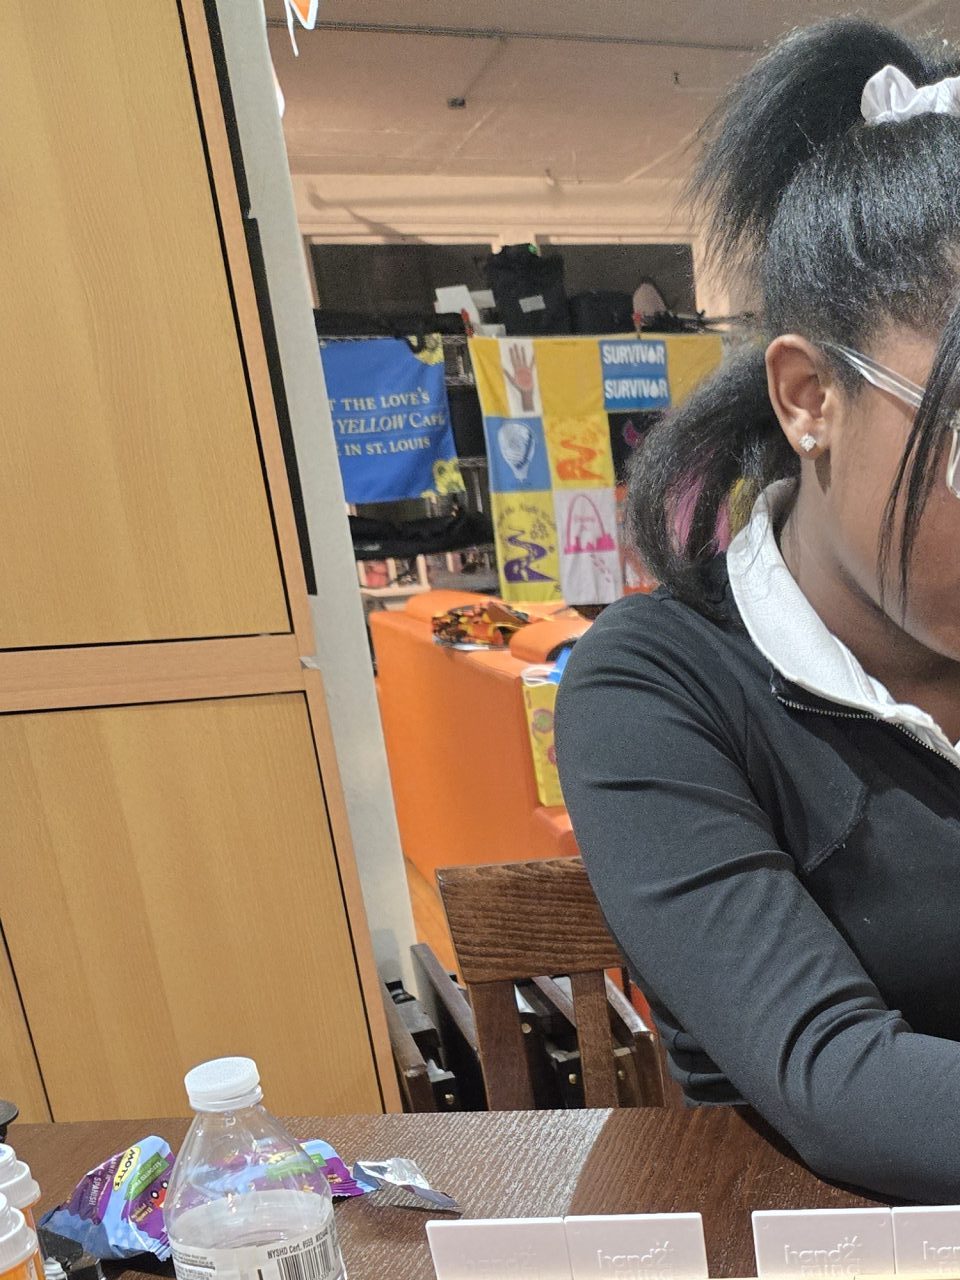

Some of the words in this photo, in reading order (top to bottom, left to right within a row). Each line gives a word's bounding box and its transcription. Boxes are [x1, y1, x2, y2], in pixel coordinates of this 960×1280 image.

[602, 344, 665, 365] SURVIVOR
[342, 397, 377, 411] THE
[380, 386, 430, 409] LOVE'S
[604, 378, 669, 399] SURVIVOR
[337, 413, 407, 434] YELLOW
[344, 443, 362, 456] IN
[366, 441, 388, 455] ST.
[389, 437, 431, 453] LOUIS
[88, 1177, 102, 1207] SPANISH
